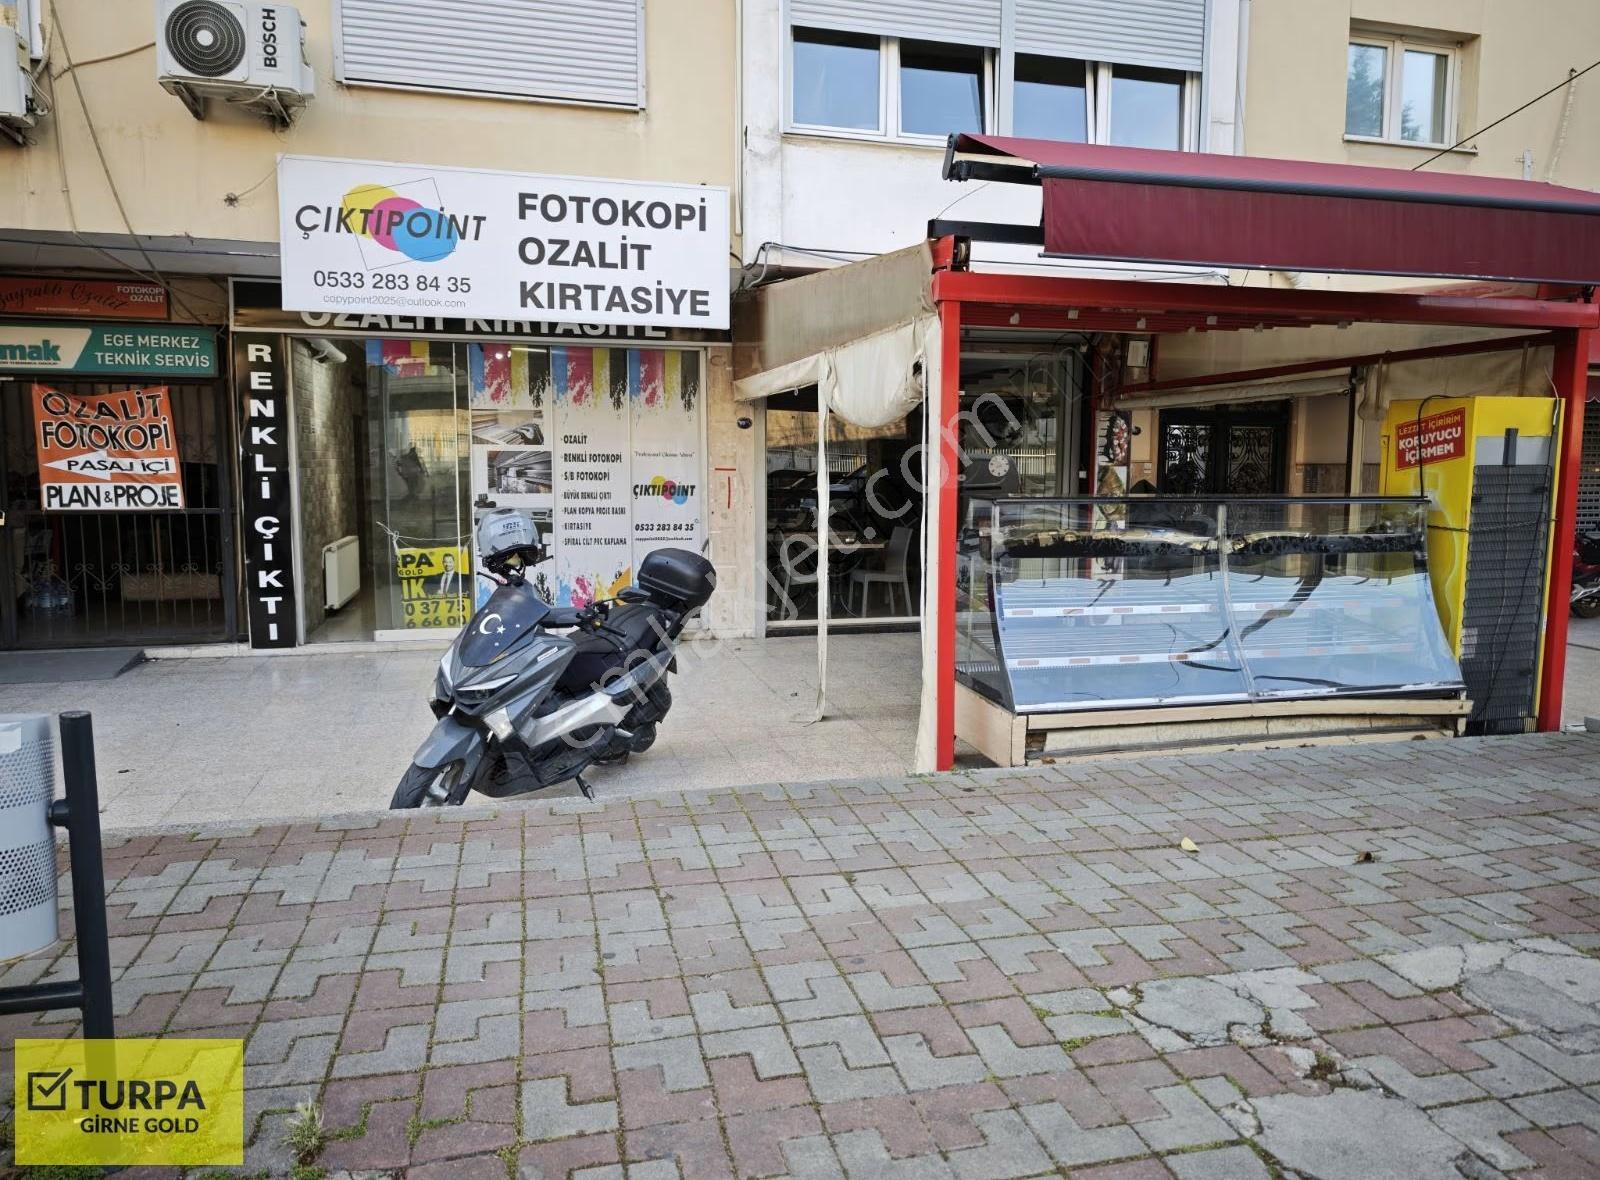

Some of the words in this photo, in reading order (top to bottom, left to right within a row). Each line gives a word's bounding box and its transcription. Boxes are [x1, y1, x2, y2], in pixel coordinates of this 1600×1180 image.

[262, 8, 278, 68] BOSCH
[295, 204, 487, 241] ÇIKTIPOİNT
[518, 192, 706, 232] FOTOKOPİ
[518, 235, 652, 270] OZALİT
[313, 270, 365, 289] 0533
[372, 273, 409, 291] 283
[416, 275, 440, 292] 84
[447, 277, 471, 293] 35
[323, 294, 466, 309] copypoint2025@outlook.com
[520, 280, 710, 317] KIRTASİYE
[103, 334, 134, 348] EGE
[137, 335, 200, 349] MERKEZ
[94, 350, 150, 366] TEKNİK
[155, 352, 210, 368] SERVİS
[42, 390, 161, 421] OZALİT
[247, 343, 278, 499] RENKLİ
[1399, 422, 1426, 435] LEZZT
[40, 416, 172, 451] FOTOKOPİ
[563, 432, 588, 444] OZALİT
[1398, 426, 1462, 450] KORUYUCU
[563, 450, 587, 463] RENKLİ
[589, 451, 622, 463] FOTOKOPİ
[1405, 442, 1455, 464] İÇİRMEM
[67, 460, 134, 471] PASAJ
[140, 459, 170, 475] İÇİ
[576, 469, 610, 481] FOTOKOPİ
[632, 481, 696, 499] ÇIKTIPOİNT
[635, 523, 654, 532] 0533
[656, 523, 671, 532] 283
[673, 523, 683, 532] 84
[684, 523, 694, 532] 35
[254, 516, 284, 641] ÇIKTI
[398, 568, 424, 576] GOLD
